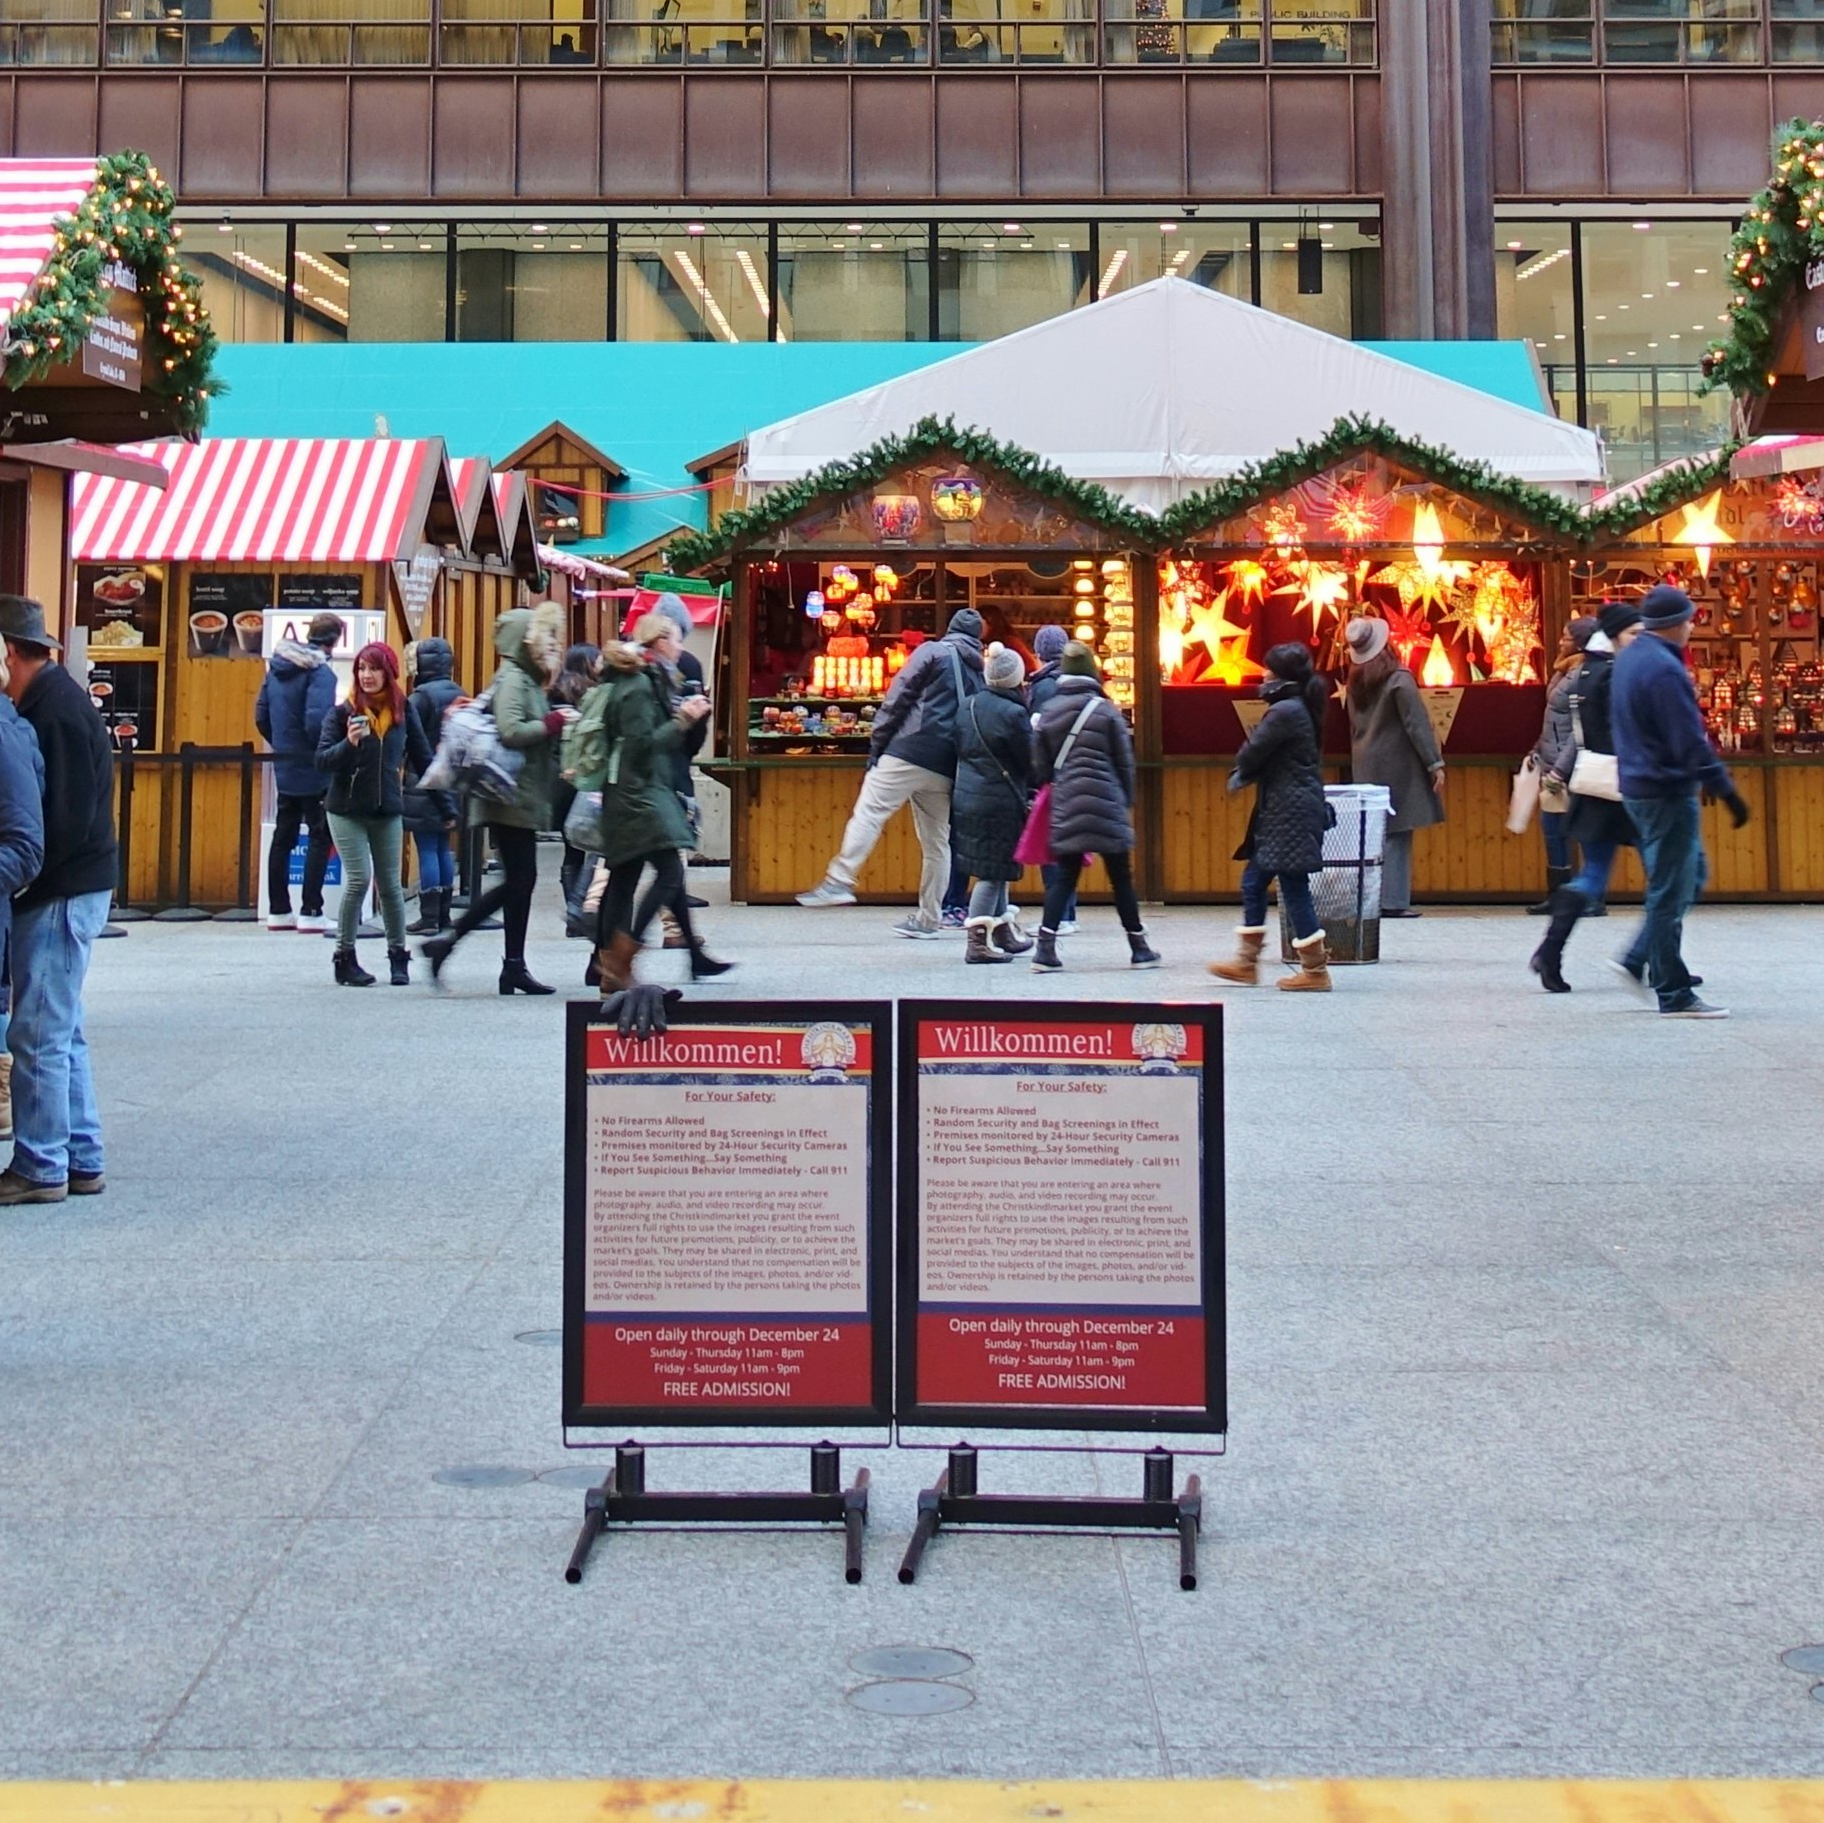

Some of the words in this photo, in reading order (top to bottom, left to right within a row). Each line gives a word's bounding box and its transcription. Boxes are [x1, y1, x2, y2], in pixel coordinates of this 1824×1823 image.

[935, 1026, 1112, 1053] Willkommen!
[604, 1037, 783, 1065] Willkommen!
[1017, 1081, 1036, 1091] For
[1038, 1082, 1067, 1091] Your
[1068, 1082, 1108, 1093] Safety:
[685, 1091, 703, 1101] For
[705, 1092, 733, 1101] Your
[736, 1092, 776, 1103] Safety:
[934, 1106, 947, 1114] No
[951, 1106, 993, 1114] Firearms
[934, 1118, 973, 1128] Random
[978, 1119, 1016, 1128] Security
[1021, 1119, 1038, 1127] and
[1042, 1119, 1059, 1129] Bag
[1063, 1120, 1115, 1130] Screenings
[1131, 1120, 1158, 1128] Effect
[602, 1129, 642, 1138] Random
[645, 1129, 685, 1138] Security
[689, 1129, 706, 1137] and
[710, 1129, 727, 1139] Bag
[731, 1129, 783, 1139] Screenings
[799, 1129, 826, 1137] Effect
[933, 1131, 978, 1139] Premises
[1036, 1132, 1047, 1141] by
[1050, 1129, 1089, 1140] 24-Hour
[1092, 1129, 1132, 1142] Security
[1135, 1133, 1179, 1141] Cameras
[601, 1141, 646, 1149] Premises
[704, 1142, 715, 1151] by
[719, 1141, 757, 1149] 24-Hour
[761, 1142, 800, 1150] Security
[934, 1143, 941, 1152] If
[943, 1143, 962, 1151] You
[964, 1144, 981, 1153] See
[1065, 1144, 1119, 1155] Something
[601, 1153, 608, 1161] If
[632, 1153, 649, 1161] See
[734, 1154, 787, 1163] Something
[933, 1155, 966, 1165] Report
[969, 1156, 1021, 1164] Suspicious
[1023, 1156, 1068, 1166] Behavior
[1070, 1157, 1134, 1168] Immediately
[1142, 1157, 1160, 1165] Call
[600, 1166, 634, 1175] Report
[637, 1166, 689, 1174] Suspicious
[692, 1165, 735, 1175] Behavior
[808, 1166, 828, 1174] Call
[829, 1166, 847, 1174] 911
[949, 1318, 985, 1334] Open
[990, 1319, 1021, 1335] daily
[1025, 1320, 1079, 1336] through
[1084, 1321, 1152, 1333] December
[1158, 1321, 1173, 1334] 24
[615, 1328, 652, 1342] Open
[655, 1328, 687, 1343] daily
[691, 1328, 745, 1344] through
[749, 1328, 818, 1341] December
[822, 1328, 839, 1341] 24
[985, 1338, 1022, 1350] Sunday
[1030, 1339, 1076, 1351] Thursday
[1080, 1340, 1107, 1349] 11am
[1115, 1340, 1138, 1352] 8pm
[650, 1347, 688, 1359] Sunday
[696, 1347, 742, 1358] Thursday
[745, 1348, 774, 1357] 11am
[781, 1348, 804, 1359] 8pm
[988, 1354, 1019, 1366] Friday
[1027, 1355, 1072, 1367] Saturday
[1076, 1356, 1103, 1365] 11am
[1111, 1356, 1134, 1367] 9pm
[654, 1363, 685, 1374] Friday
[692, 1363, 738, 1374] Saturday
[741, 1363, 769, 1373] 11am
[776, 1364, 800, 1375] 9pm
[998, 1374, 1032, 1387] FREE
[1036, 1374, 1126, 1390] ADMISSION!
[663, 1382, 697, 1395] FREE
[701, 1382, 790, 1395] ADMISSION!
